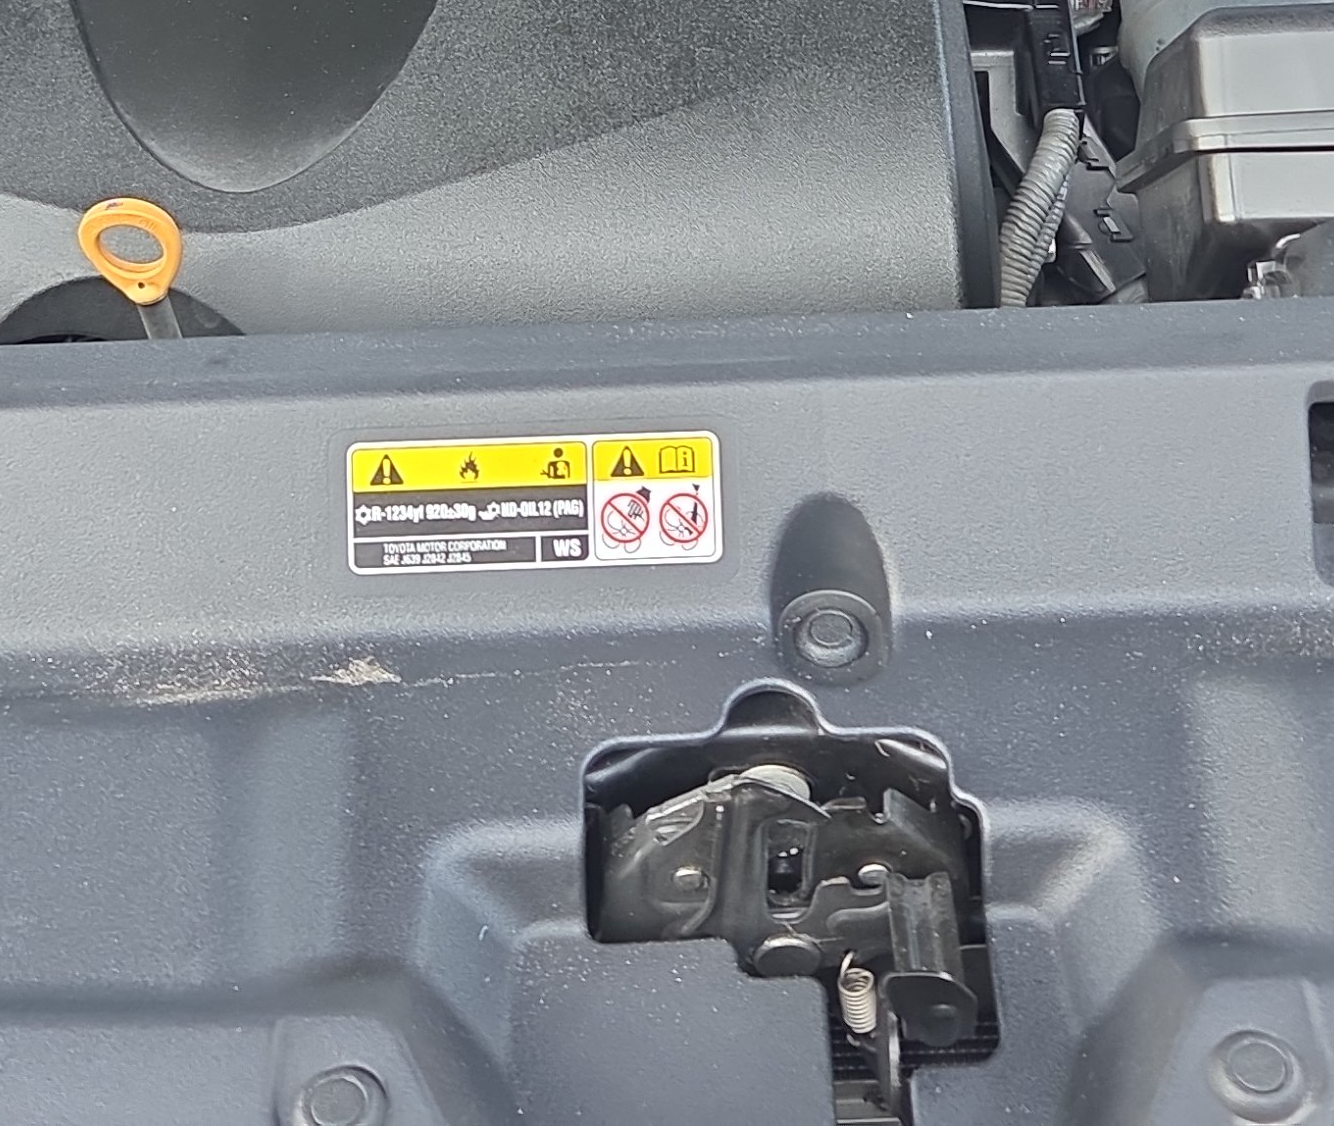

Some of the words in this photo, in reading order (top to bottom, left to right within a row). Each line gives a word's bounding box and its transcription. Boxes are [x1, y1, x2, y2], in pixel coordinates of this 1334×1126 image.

[553, 499, 584, 519] (PAG)
[383, 542, 415, 554] TOYOTA
[416, 540, 447, 553] MOTOR
[448, 538, 507, 552] CORPORATION
[553, 538, 582, 557] WS
[383, 554, 400, 566] SAE
